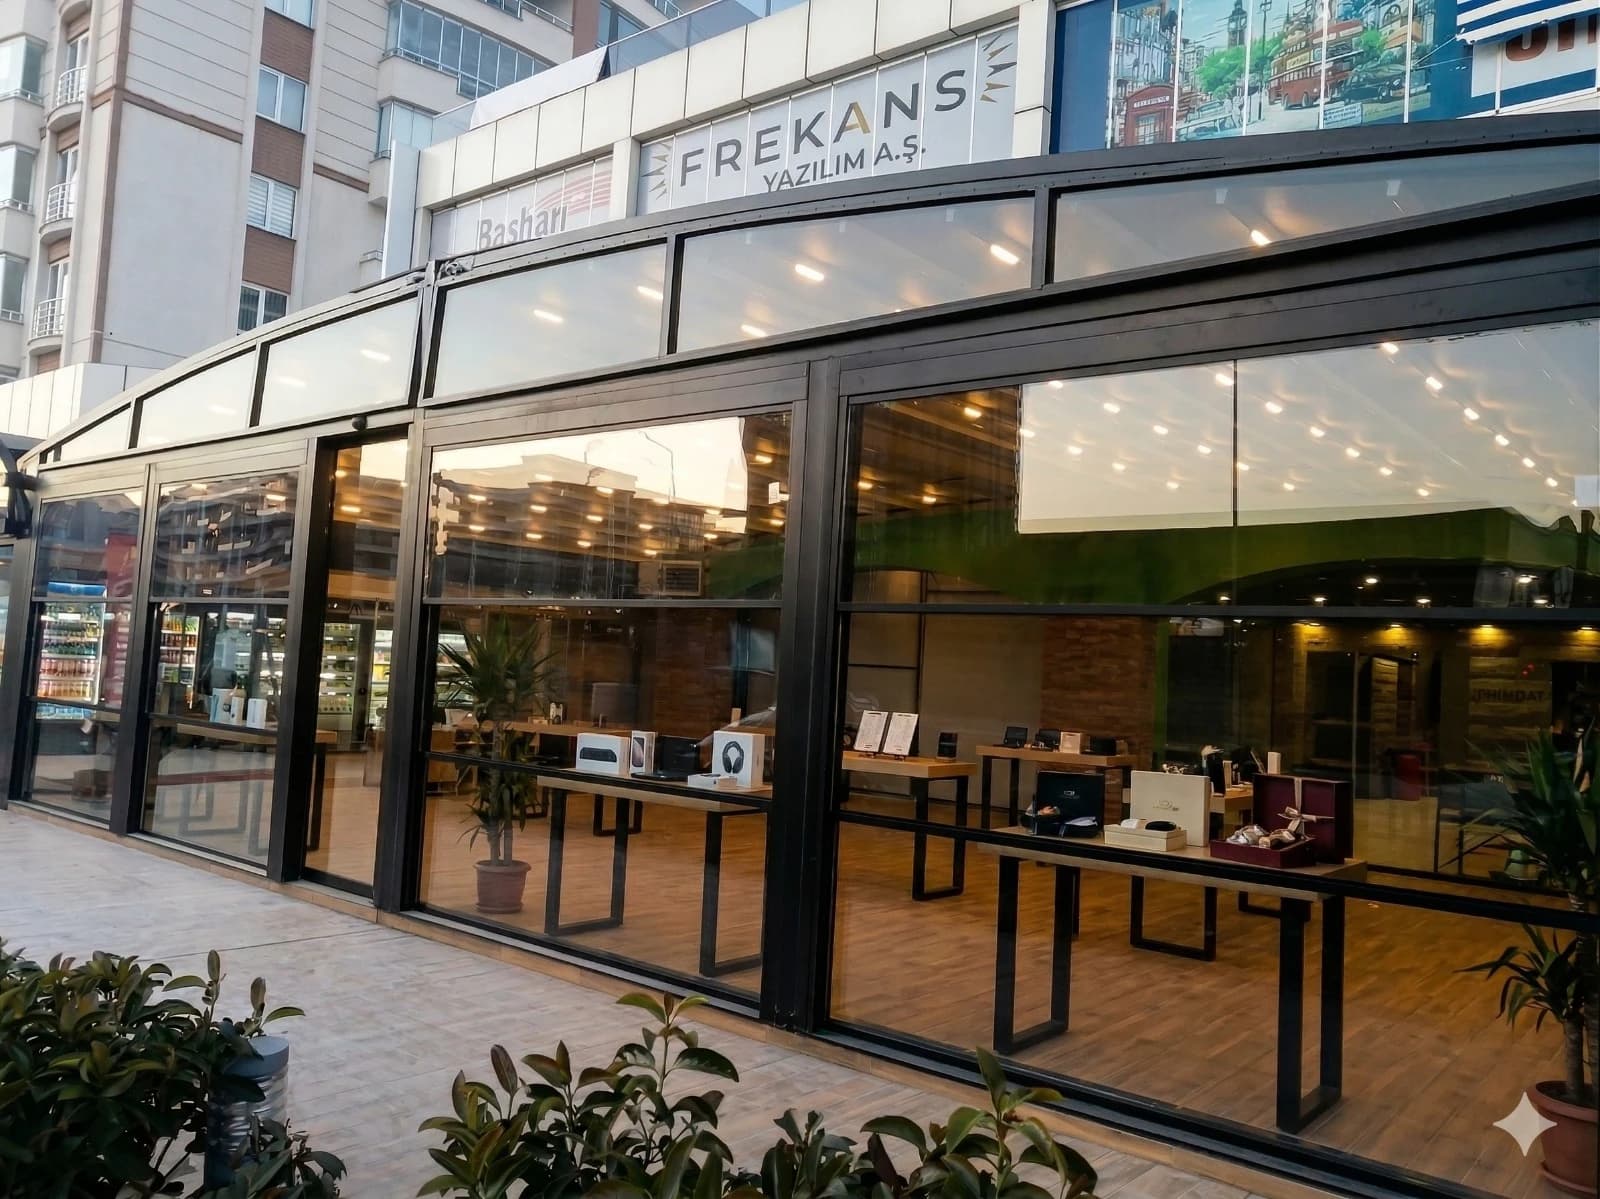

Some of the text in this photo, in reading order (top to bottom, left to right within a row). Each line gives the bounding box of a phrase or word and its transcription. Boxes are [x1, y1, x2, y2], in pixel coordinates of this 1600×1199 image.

[680, 69, 967, 187] FREKANS
[763, 134, 926, 193] YAZILIM A.Ş.
